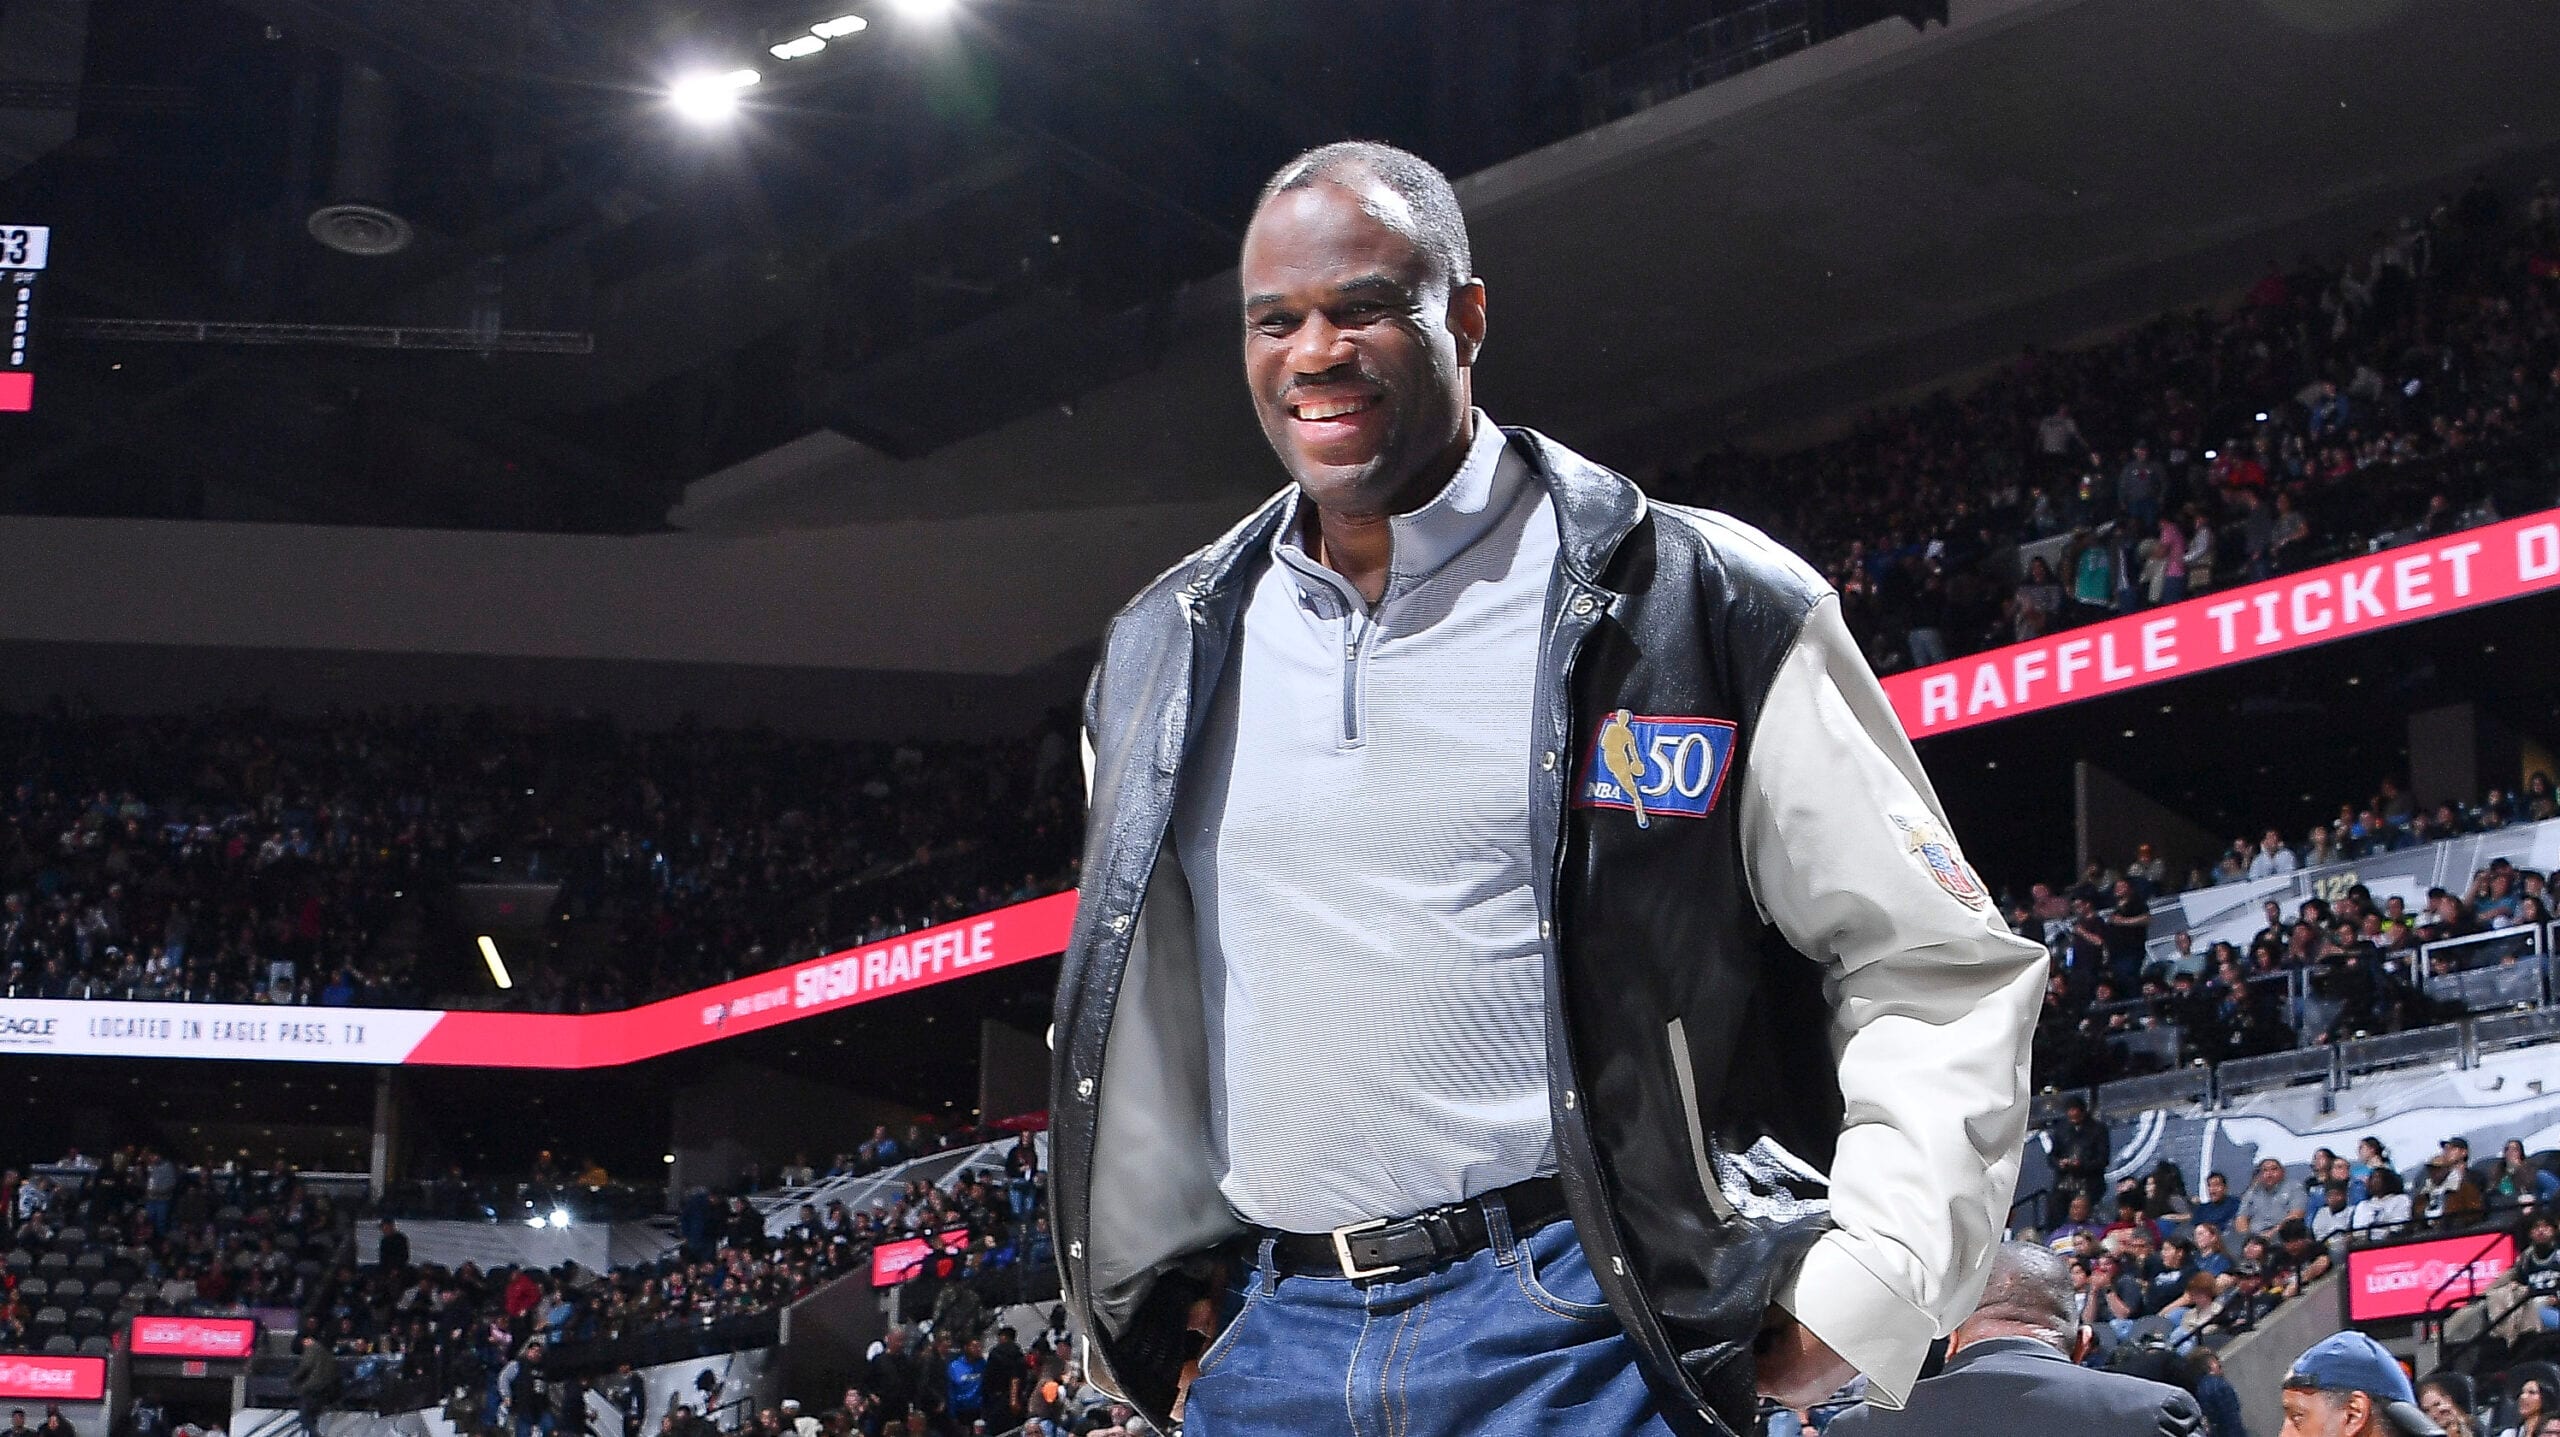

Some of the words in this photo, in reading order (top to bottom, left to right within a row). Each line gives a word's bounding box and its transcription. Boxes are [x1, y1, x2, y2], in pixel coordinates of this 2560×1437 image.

[0, 229, 28, 264] 3
[1921, 617, 2178, 726] RAFFLE
[2208, 541, 2482, 655] TICKET
[2516, 523, 2559, 581] D
[1640, 732, 1713, 798] 50
[1587, 782, 1621, 799] NBA
[864, 921, 994, 990] RAFFLE
[89, 1017, 171, 1039] LOCATED
[182, 1020, 201, 1040] IN
[212, 1021, 267, 1042] EAGLE
[345, 1024, 366, 1044] TX
